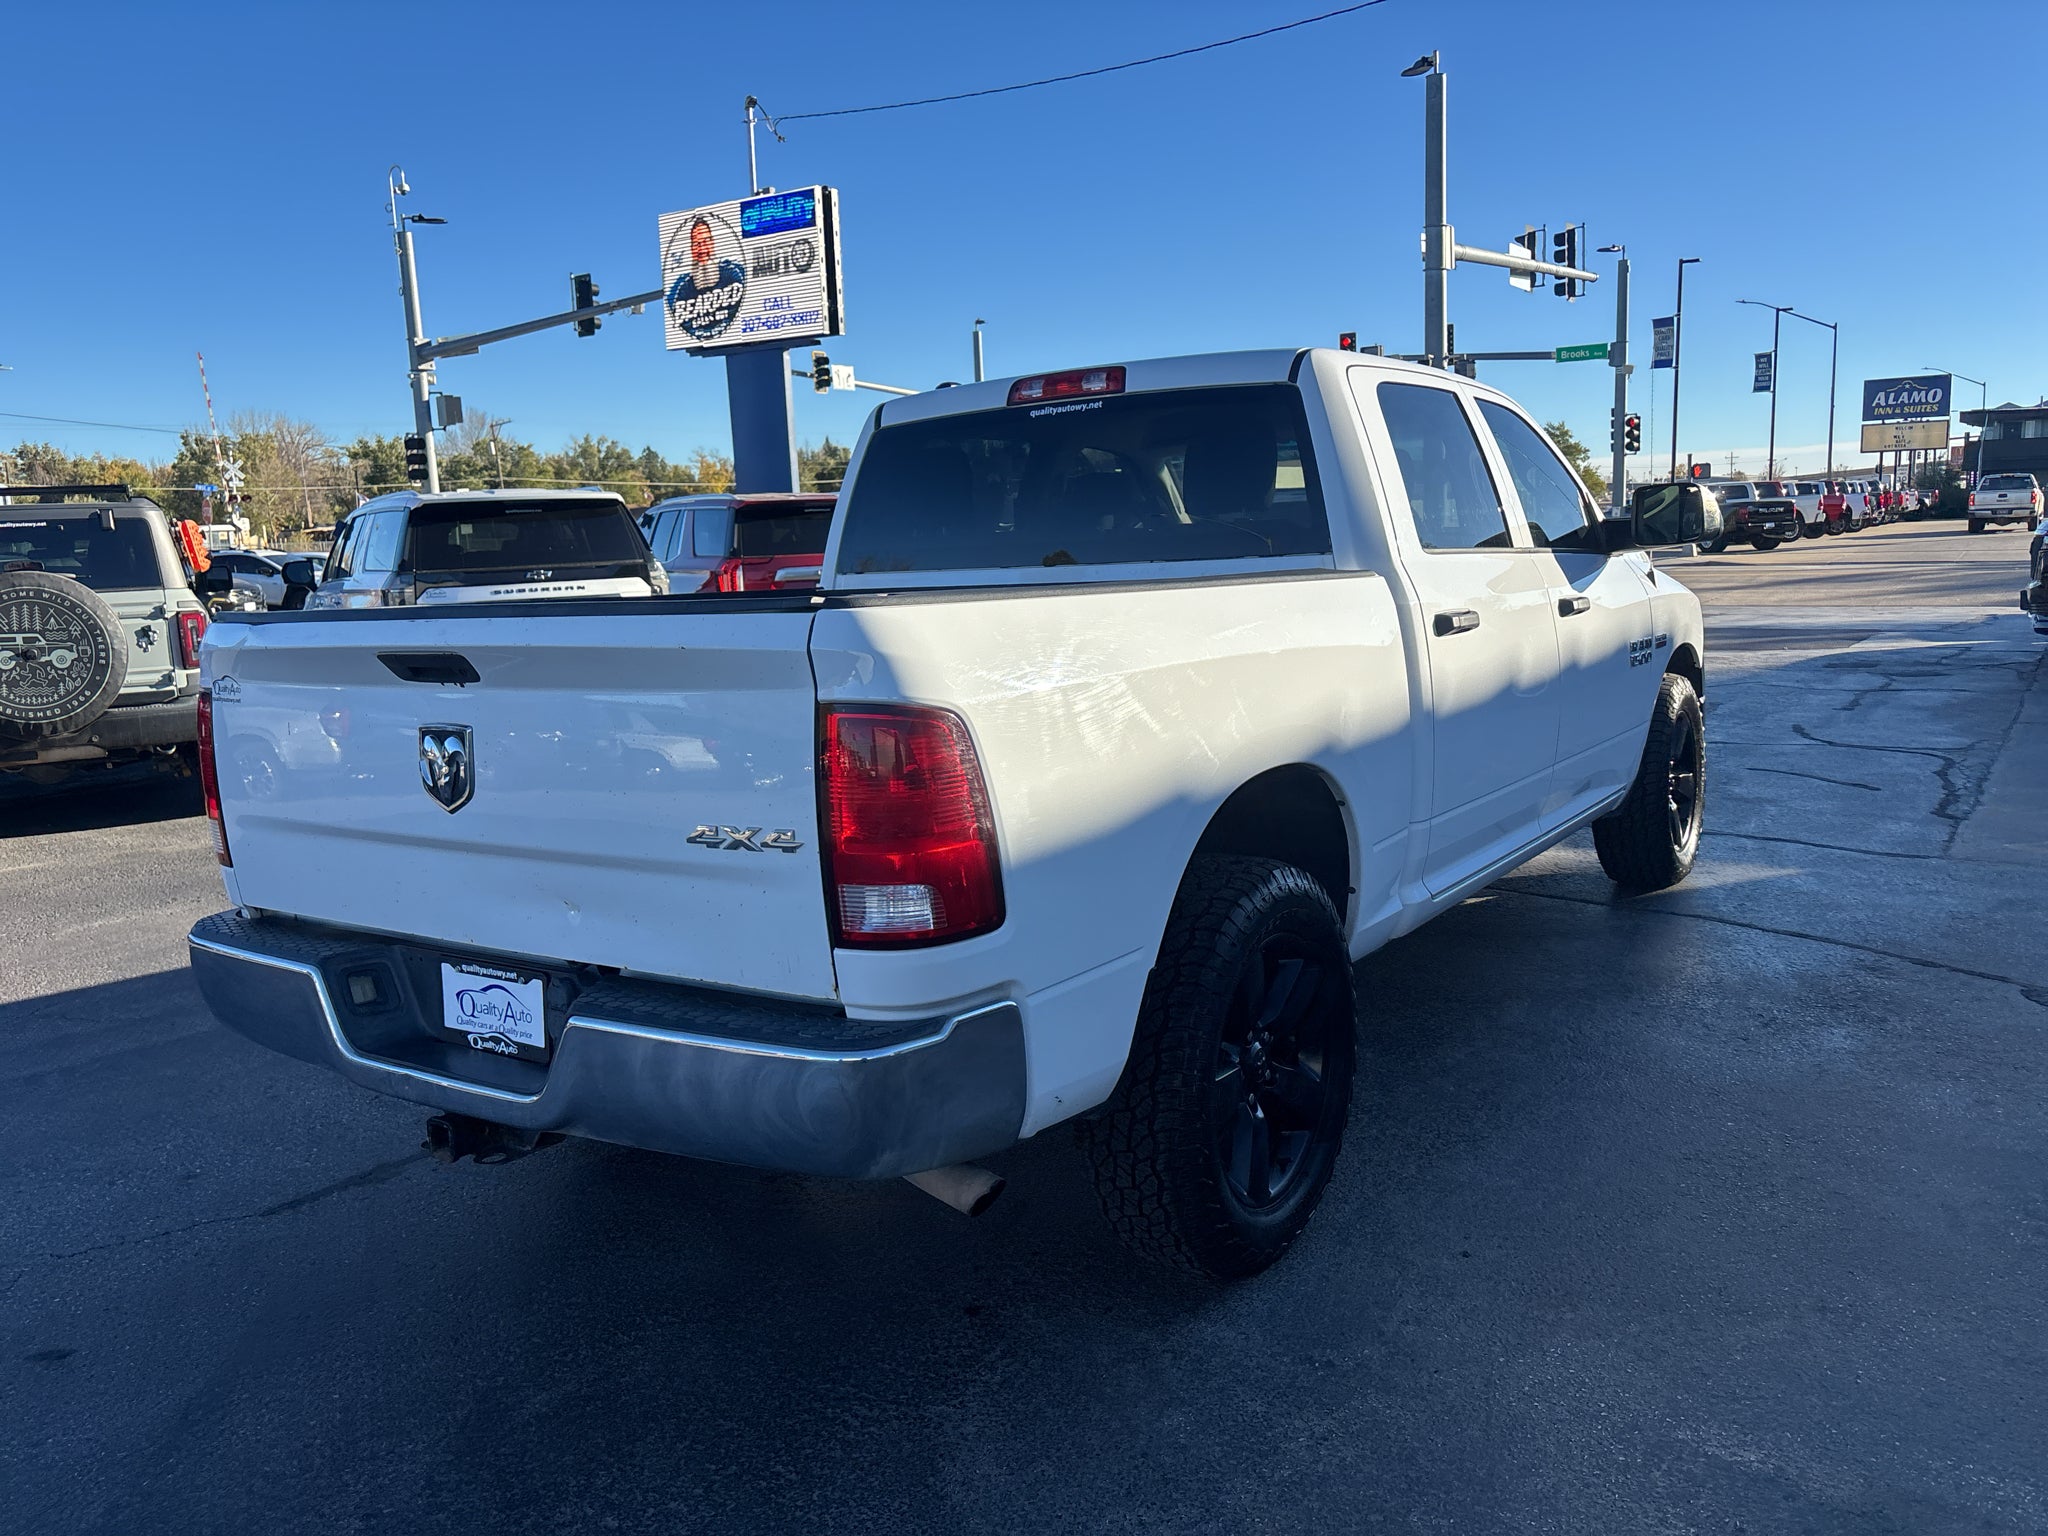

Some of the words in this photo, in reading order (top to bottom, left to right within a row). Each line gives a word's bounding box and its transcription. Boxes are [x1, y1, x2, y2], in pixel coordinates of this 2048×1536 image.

[1561, 350, 1590, 359] Brooks
[1872, 388, 1943, 407] ALAMO
[1029, 401, 1103, 418] qualityautowy.net
[1874, 407, 1893, 415] INN
[1903, 403, 1939, 414] SUITES
[0, 521, 47, 529] ualityautowy.net
[2, 591, 35, 600] SOME
[42, 592, 71, 606] WILD
[75, 607, 95, 625] OUT
[94, 629, 106, 665] THERE
[0, 706, 61, 718] BLISHED
[66, 690, 91, 709] 1966
[462, 964, 518, 981] qualityautowy.net
[456, 1015, 477, 1028] Quality
[477, 1021, 488, 1029] cars
[499, 1023, 520, 1037] Quality
[520, 1030, 533, 1039] price
